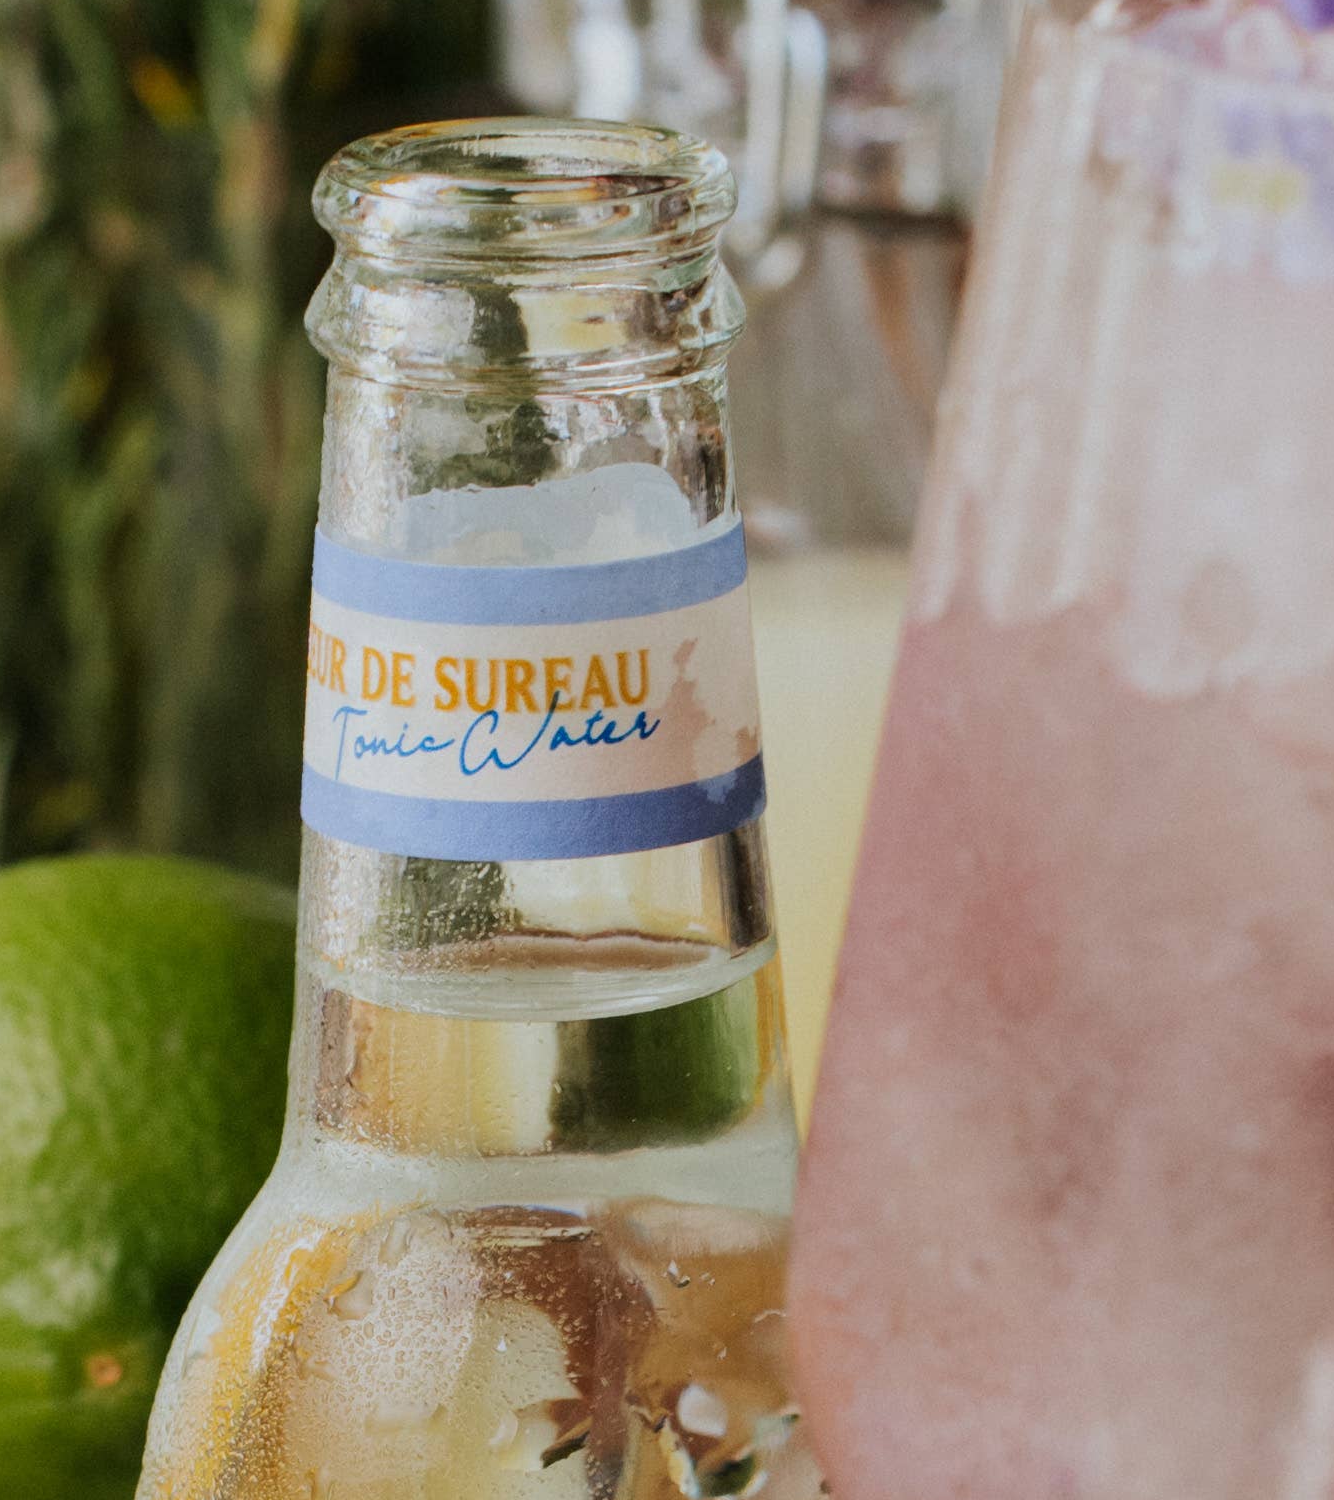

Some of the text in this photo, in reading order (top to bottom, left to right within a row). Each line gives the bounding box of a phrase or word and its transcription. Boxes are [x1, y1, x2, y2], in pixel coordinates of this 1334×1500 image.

[361, 646, 415, 708] DE
[433, 648, 651, 715] SUREAU
[332, 690, 661, 780] Tonic Water
